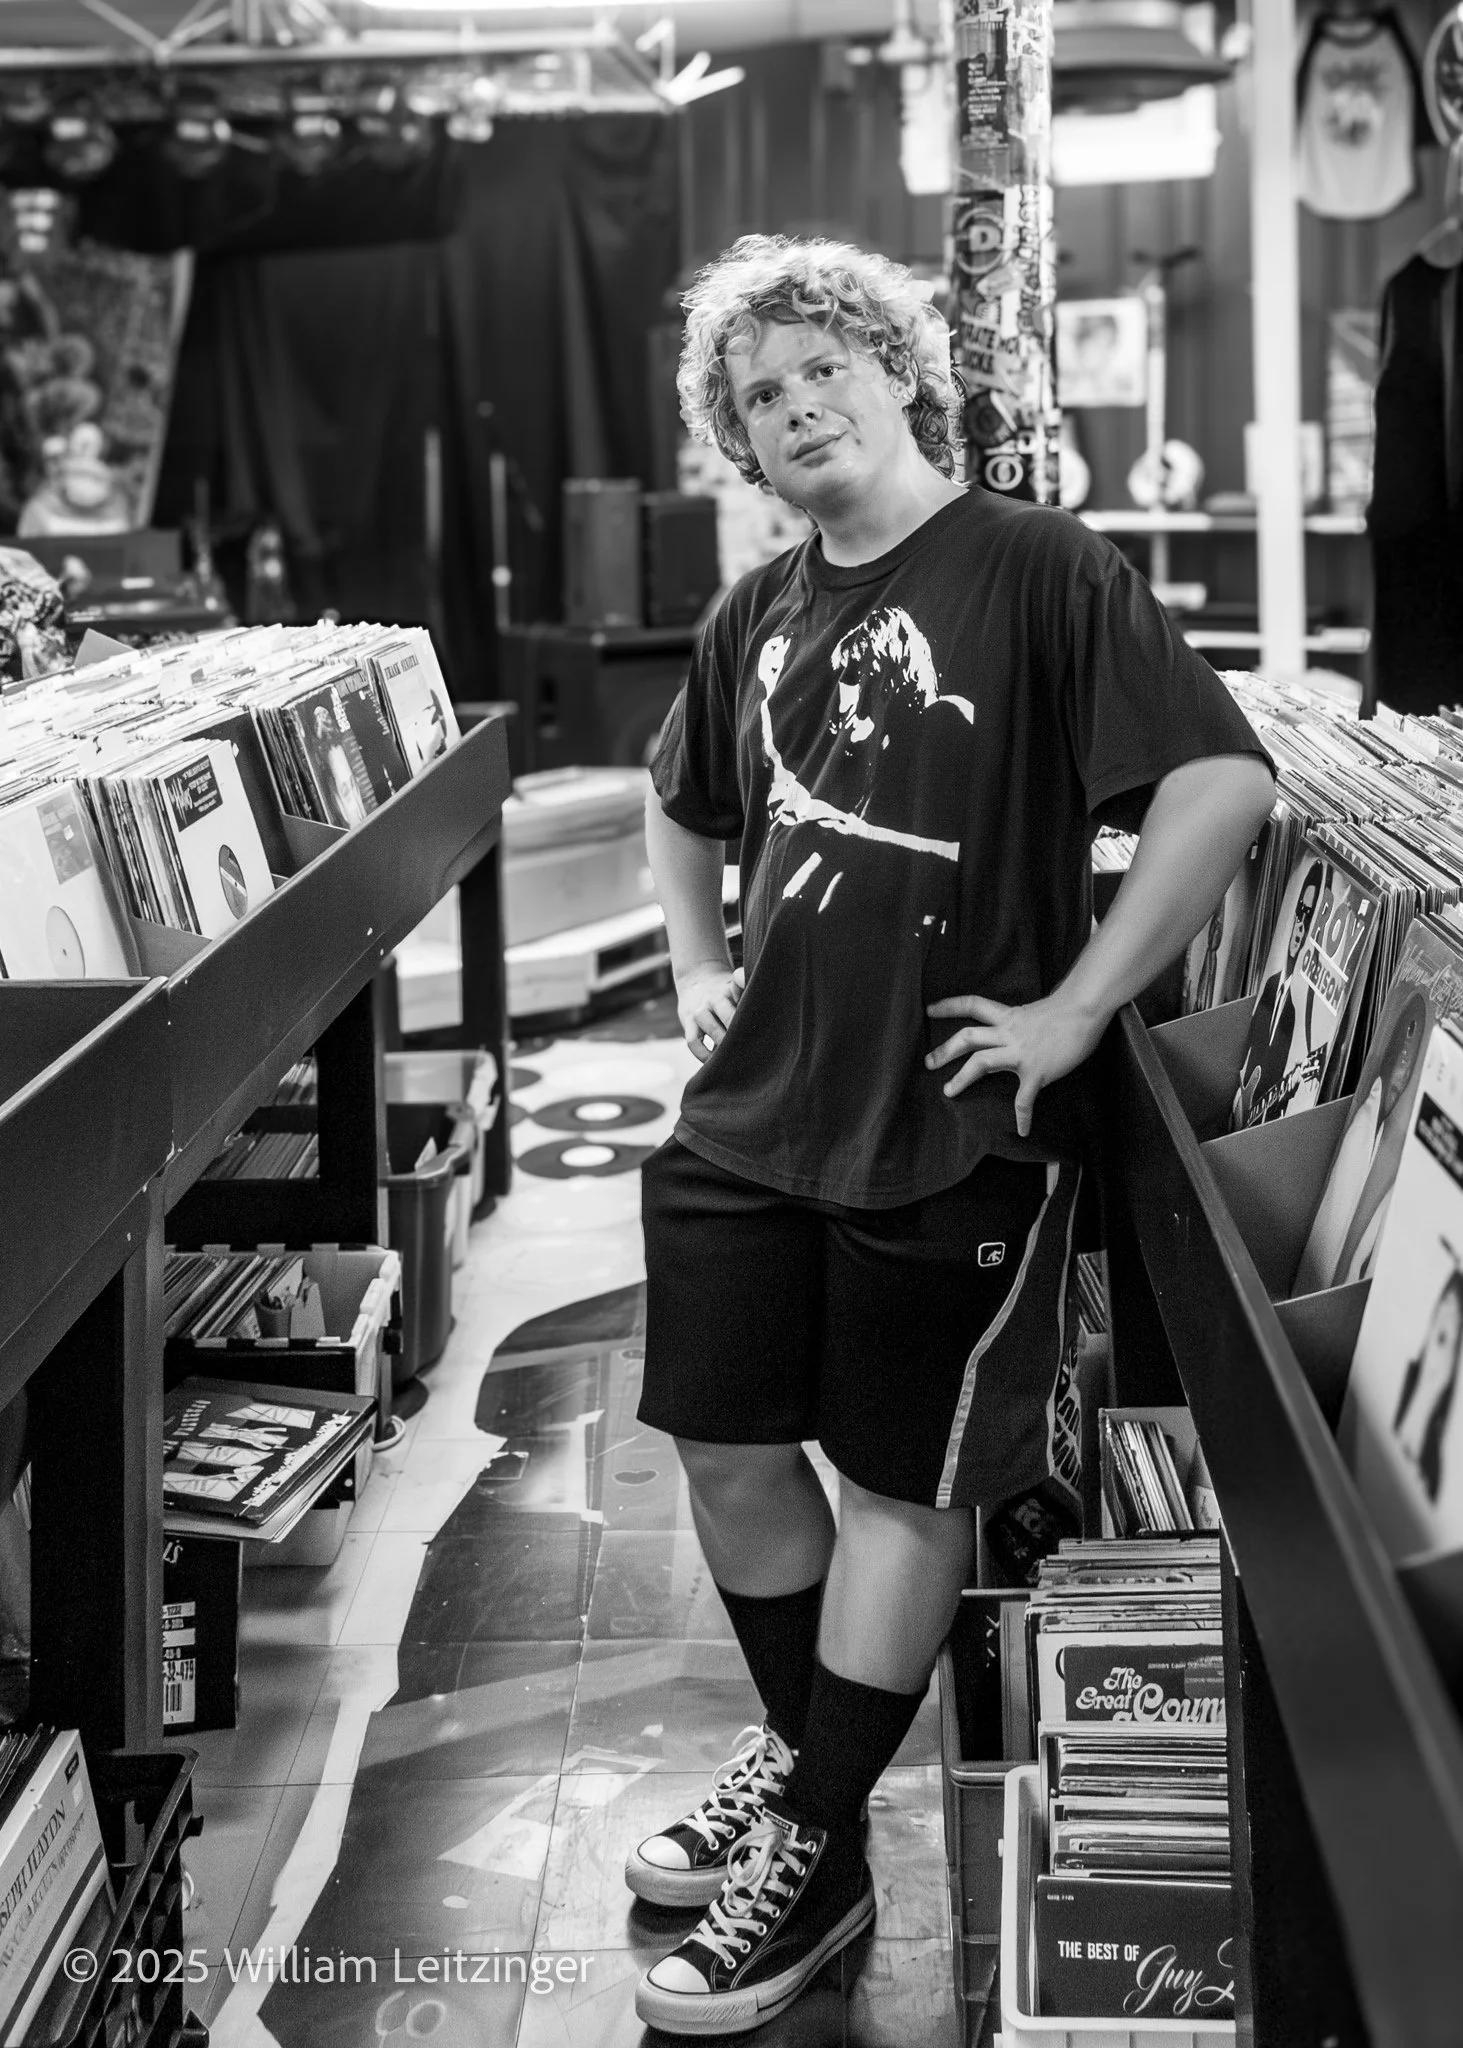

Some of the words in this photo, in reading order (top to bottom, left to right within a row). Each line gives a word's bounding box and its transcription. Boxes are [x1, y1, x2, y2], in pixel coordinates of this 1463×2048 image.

[1310, 886, 1365, 974] ROY
[1302, 949, 1343, 1012] ORBISON
[1103, 1667, 1143, 1690] The
[1075, 1687, 1133, 1710] Great
[27, 1800, 66, 1881] HAYDN
[1057, 1940, 1082, 1959] THE
[1088, 1942, 1119, 1961] BEST
[1124, 1944, 1140, 1962] OF
[1123, 1944, 1207, 2015] Guy
